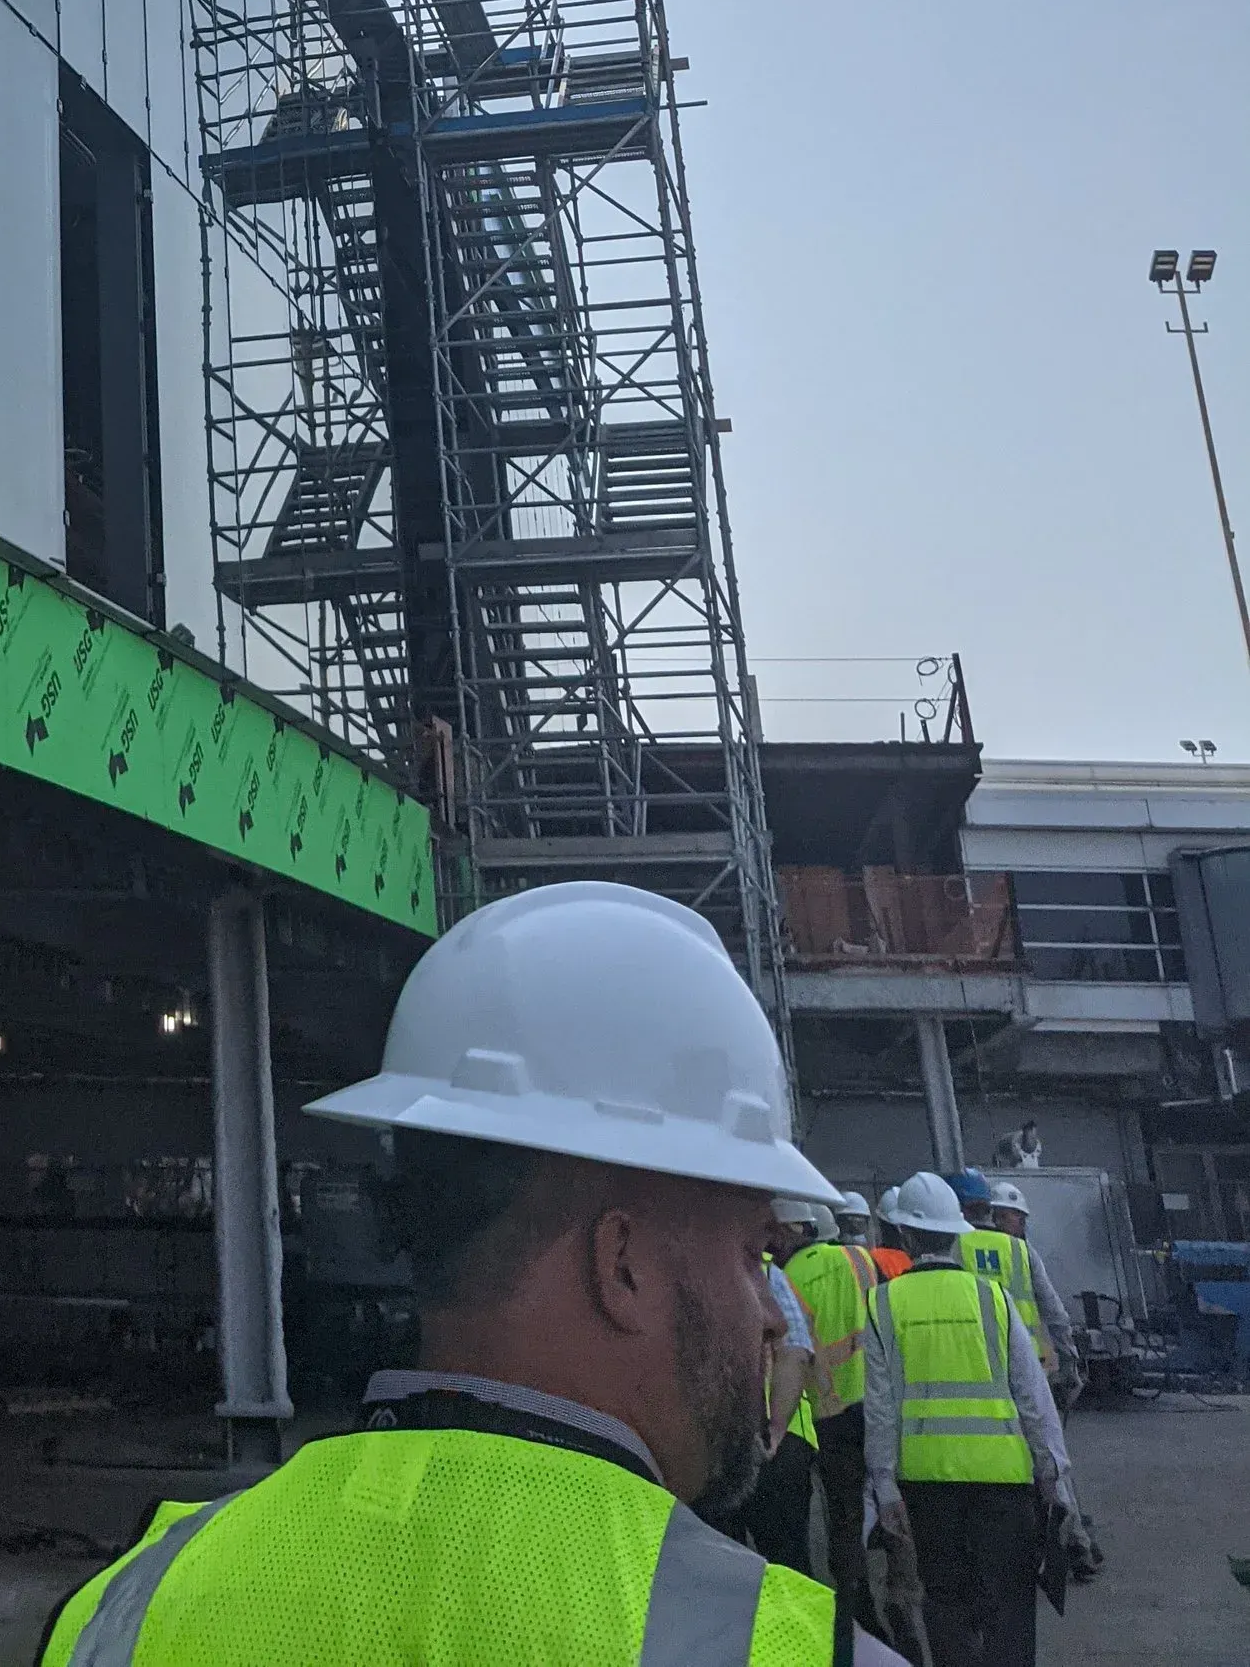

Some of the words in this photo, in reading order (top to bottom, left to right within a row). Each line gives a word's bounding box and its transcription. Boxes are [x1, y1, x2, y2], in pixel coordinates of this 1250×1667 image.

[73, 628, 93, 677] USG
[41, 669, 62, 719] USG
[147, 667, 164, 712] USG
[121, 708, 139, 753] USG
[189, 741, 204, 785] USG
